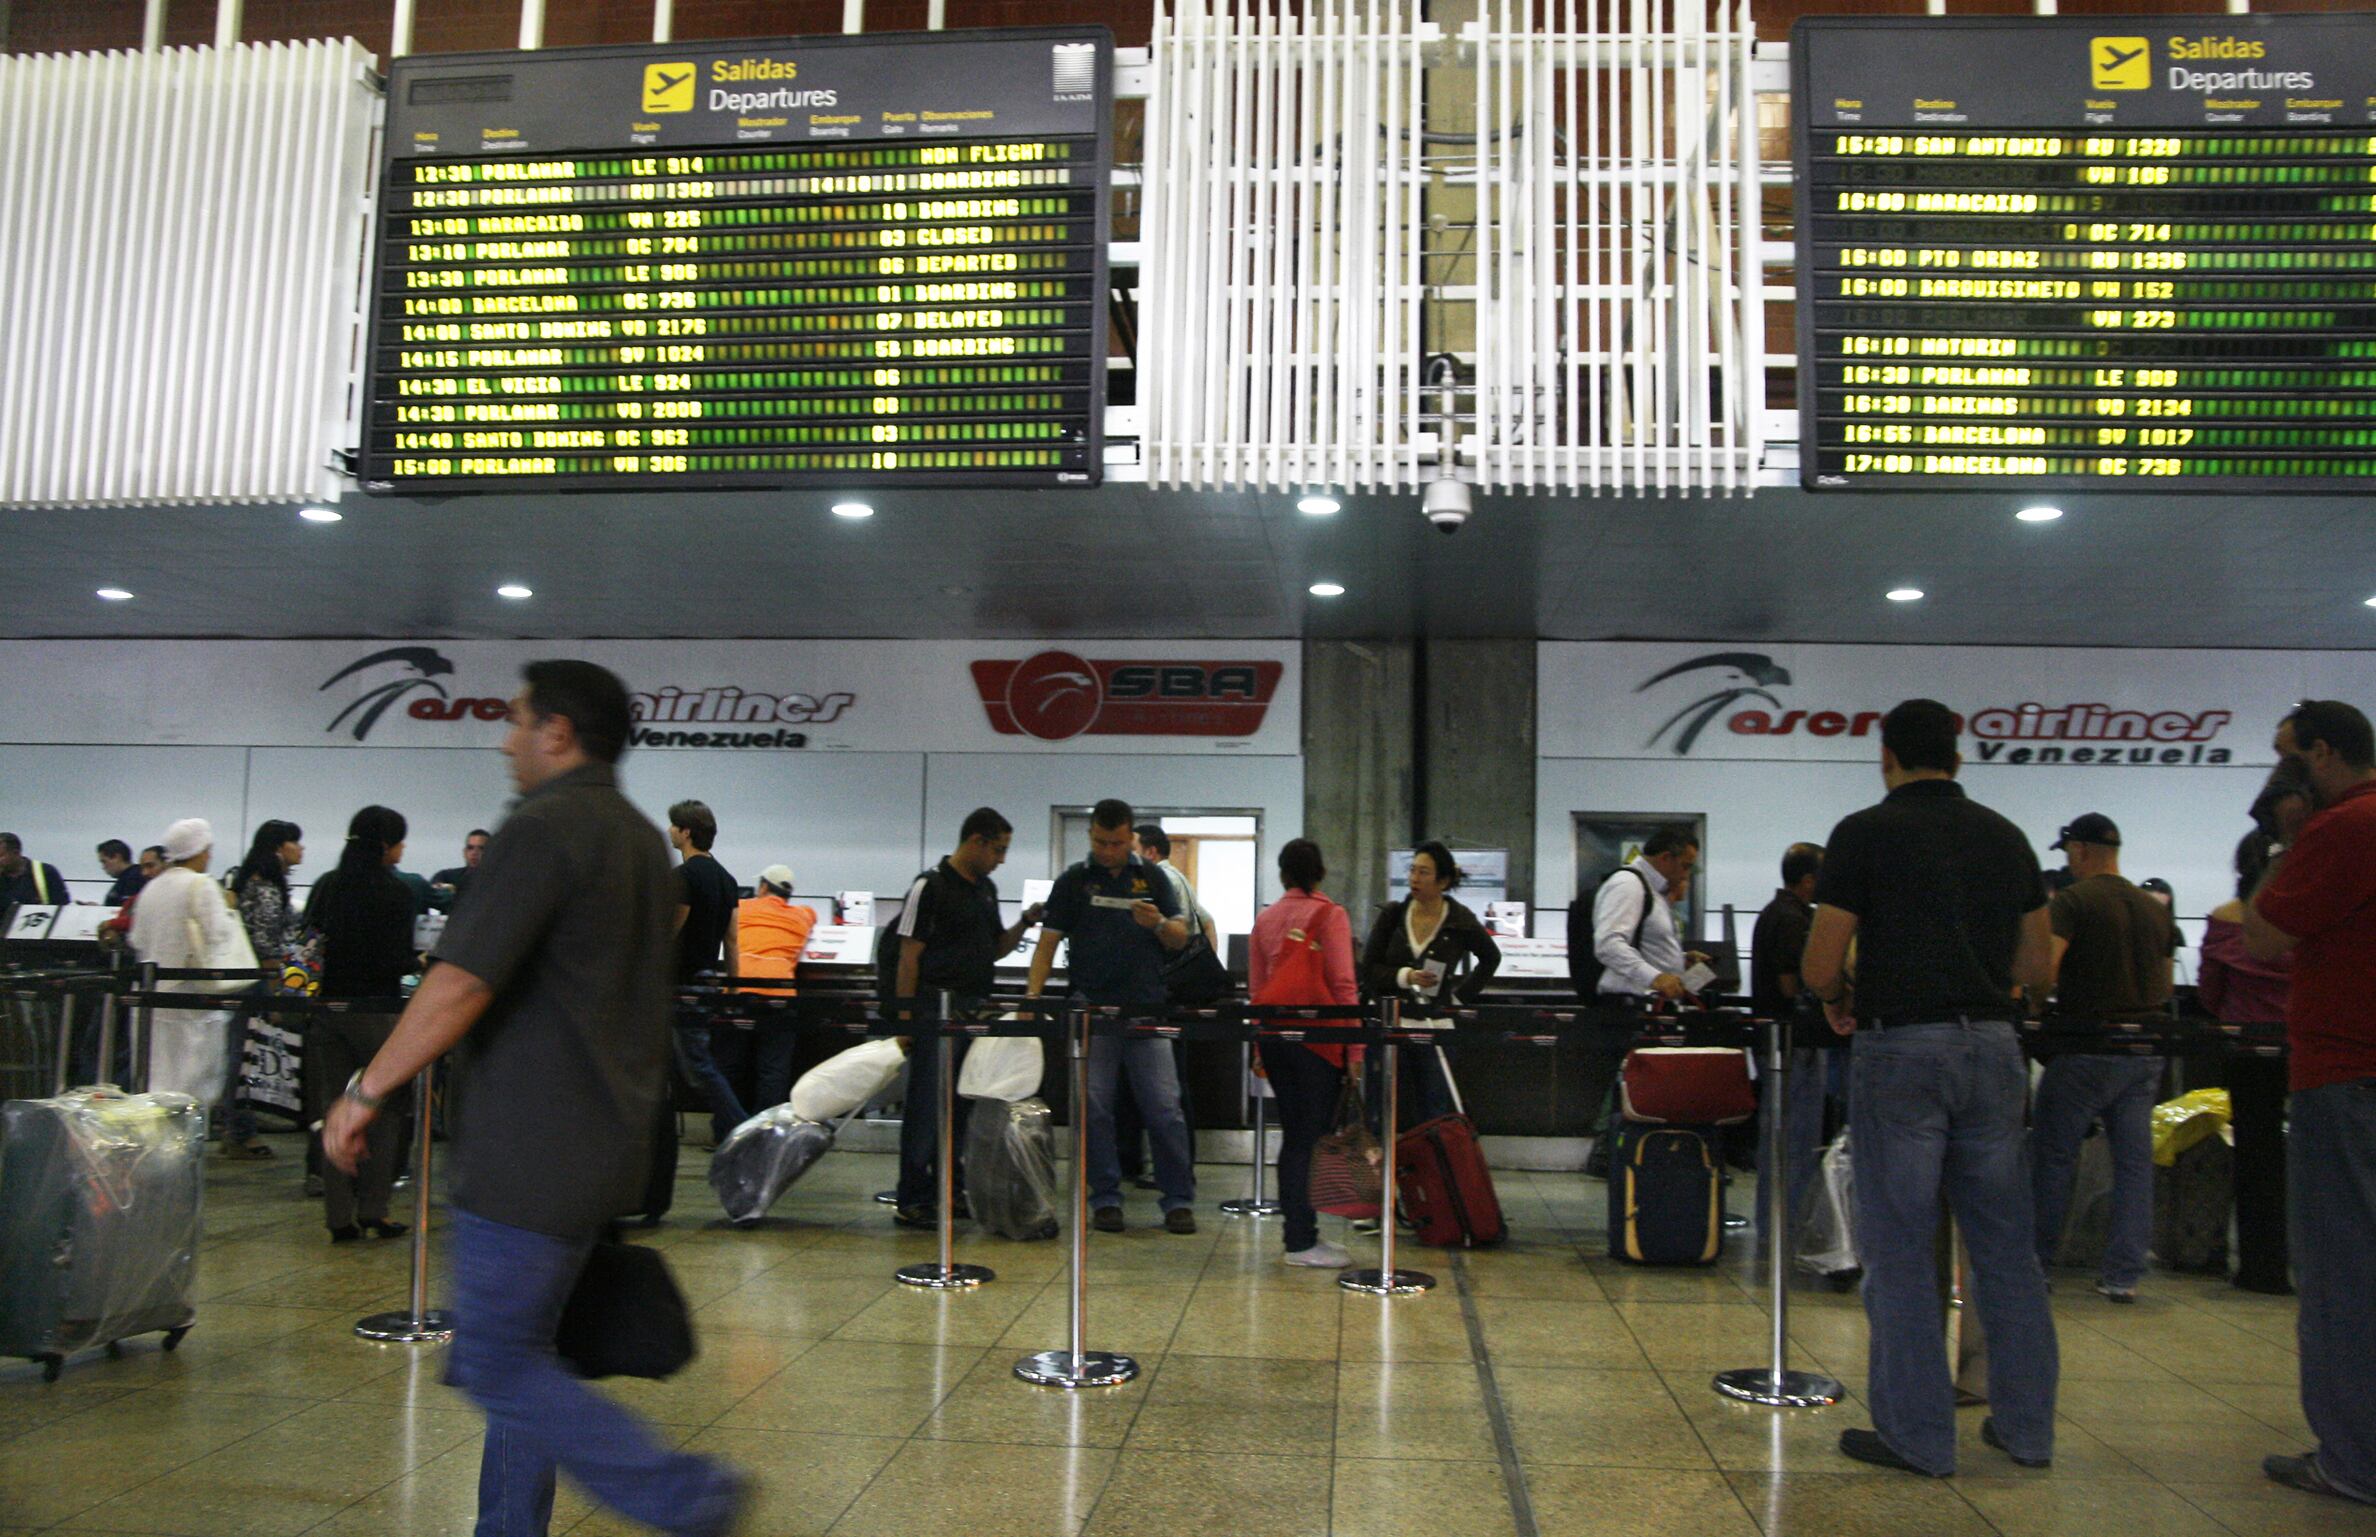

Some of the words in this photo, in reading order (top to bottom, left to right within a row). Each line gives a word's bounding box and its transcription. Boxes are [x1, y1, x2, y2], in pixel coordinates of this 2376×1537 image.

[2168, 36, 2266, 59] Salidas
[711, 58, 797, 82] Salidas
[2168, 67, 2314, 94] Departures
[709, 88, 838, 114] Departures
[2285, 99, 2344, 108] Embarque
[1837, 136, 1903, 154] 15:30
[1913, 137, 1955, 154] SAN
[1965, 138, 2061, 156] ANTONIO
[2127, 139, 2181, 156] 1320
[416, 166, 472, 182] 12:30
[482, 162, 575, 180] PORLAMAR
[632, 159, 656, 175] LE
[667, 157, 703, 174] 914
[921, 147, 958, 164] NON
[970, 144, 1044, 162] FLIGHT
[2128, 167, 2169, 184] 106
[413, 190, 471, 207] 12:30
[478, 187, 575, 205] PORLAMAR
[667, 182, 715, 198] 1302
[811, 176, 872, 193] 14:10
[884, 175, 906, 191] 11
[918, 170, 1020, 190] BOARDING
[1839, 193, 1906, 211] 16:00
[1914, 194, 2037, 212] MARACAIBO
[412, 219, 468, 235] 13:00
[478, 215, 583, 233] MARACAIBO
[664, 210, 700, 227] 225
[883, 203, 907, 220] 10
[919, 199, 1019, 219] BOARDING
[410, 244, 466, 260] 13:10
[476, 241, 569, 259] PORLAMAR
[662, 237, 698, 253] 704
[880, 230, 905, 246] 03
[917, 227, 992, 245] CLOSED
[2129, 224, 2170, 241] 714
[1841, 249, 1906, 266] 16:00
[1919, 250, 1959, 267] PTO
[1971, 251, 2039, 268] ORDAZ
[408, 271, 464, 287] 13:30
[474, 268, 567, 285] PORLAMAR
[625, 266, 649, 282] LE
[660, 264, 697, 281] 906
[879, 258, 904, 274] 06
[917, 254, 1017, 273] DEPARTED
[406, 298, 462, 314] 14:00
[473, 295, 578, 313] BARCELONA
[878, 286, 901, 302] 01
[916, 282, 1016, 301] BOARDING
[1842, 279, 1907, 296] 16:00
[1920, 280, 2080, 298] BARQUISIMETO
[2134, 282, 2173, 298] 152
[403, 325, 460, 341] 14:00
[470, 323, 529, 340] SANTO
[877, 313, 902, 330] 07
[914, 310, 1002, 329] DELAYED
[2133, 311, 2175, 328] 273
[402, 351, 458, 367] 14:15
[468, 349, 562, 366] PORLAMAR
[657, 346, 704, 362] 1024
[875, 341, 901, 357] 5B
[913, 338, 1014, 356] BOARDING
[1843, 337, 1909, 355] 16:10
[1920, 338, 2016, 356] MATURIN
[400, 379, 457, 395] 14:30
[467, 379, 491, 394] EL
[501, 377, 561, 393] VIGIA
[618, 375, 643, 391] LE
[654, 374, 690, 390] 924
[874, 369, 900, 386] 06
[1844, 366, 1910, 384] 16:30
[1921, 367, 2030, 385] PORLAMAR
[2096, 370, 2123, 386] LE
[398, 406, 455, 421] 14:30
[465, 404, 559, 421] PORLAMAR
[1845, 396, 1911, 413] 16:30
[1923, 397, 2018, 415] BARINAS
[2137, 399, 2191, 416] 2134
[396, 433, 453, 448] 14:40
[464, 432, 522, 448] SANTO
[872, 425, 898, 442] 03
[1845, 425, 1911, 443] 16:55
[1922, 426, 2045, 444] BARCELONA
[2140, 429, 2193, 445] 1017
[395, 459, 451, 474] 15:00
[462, 458, 555, 474] PORLAMAR
[650, 456, 686, 472] 306
[872, 453, 897, 469] 10
[1846, 455, 1912, 472] 17:00
[1925, 456, 2046, 474] BARCELONA
[1110, 667, 1255, 697] SBA
[629, 683, 854, 723] airlines
[1971, 703, 2232, 741] airlines
[629, 728, 808, 748] Venezuela
[1976, 740, 2233, 765] Venezuela
